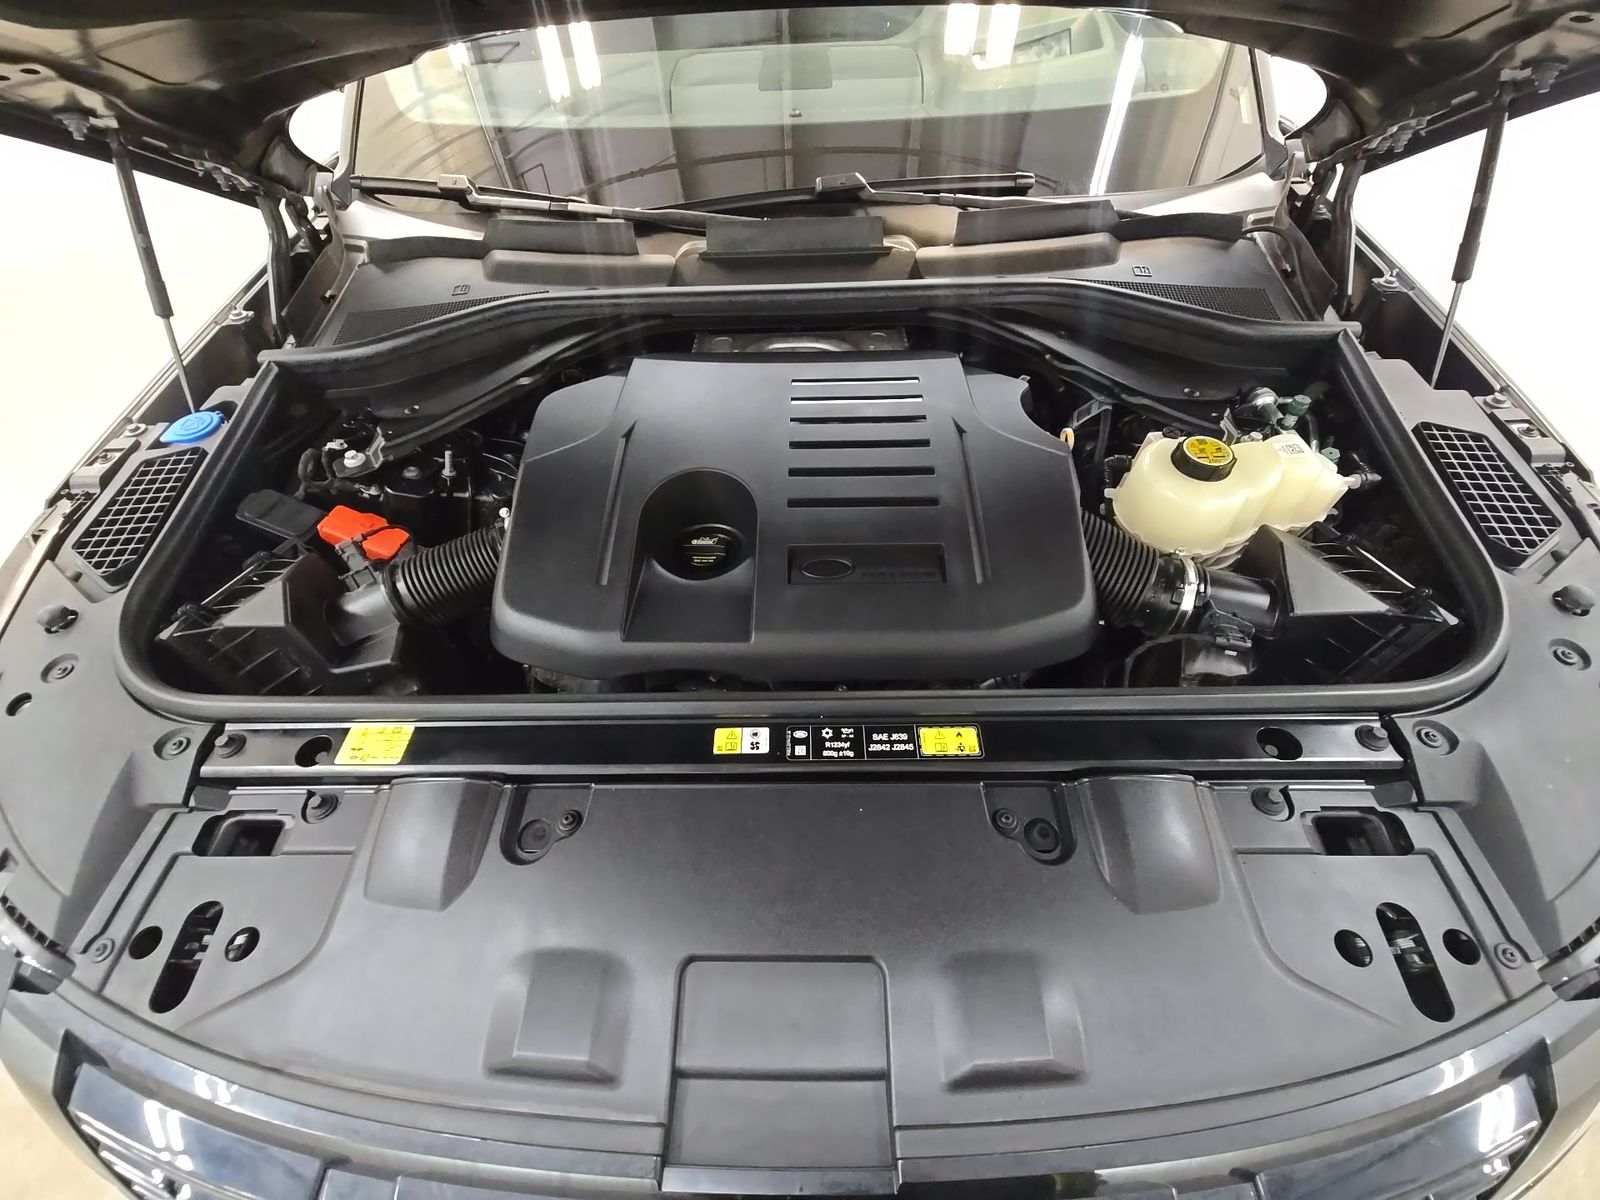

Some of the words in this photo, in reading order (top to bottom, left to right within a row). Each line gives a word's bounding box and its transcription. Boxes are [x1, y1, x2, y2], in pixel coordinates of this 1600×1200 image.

[872, 733, 889, 741] SAE
[889, 733, 908, 741] J639
[824, 741, 850, 749] R1234yf
[868, 743, 891, 752] J2842
[892, 743, 915, 751] J2845
